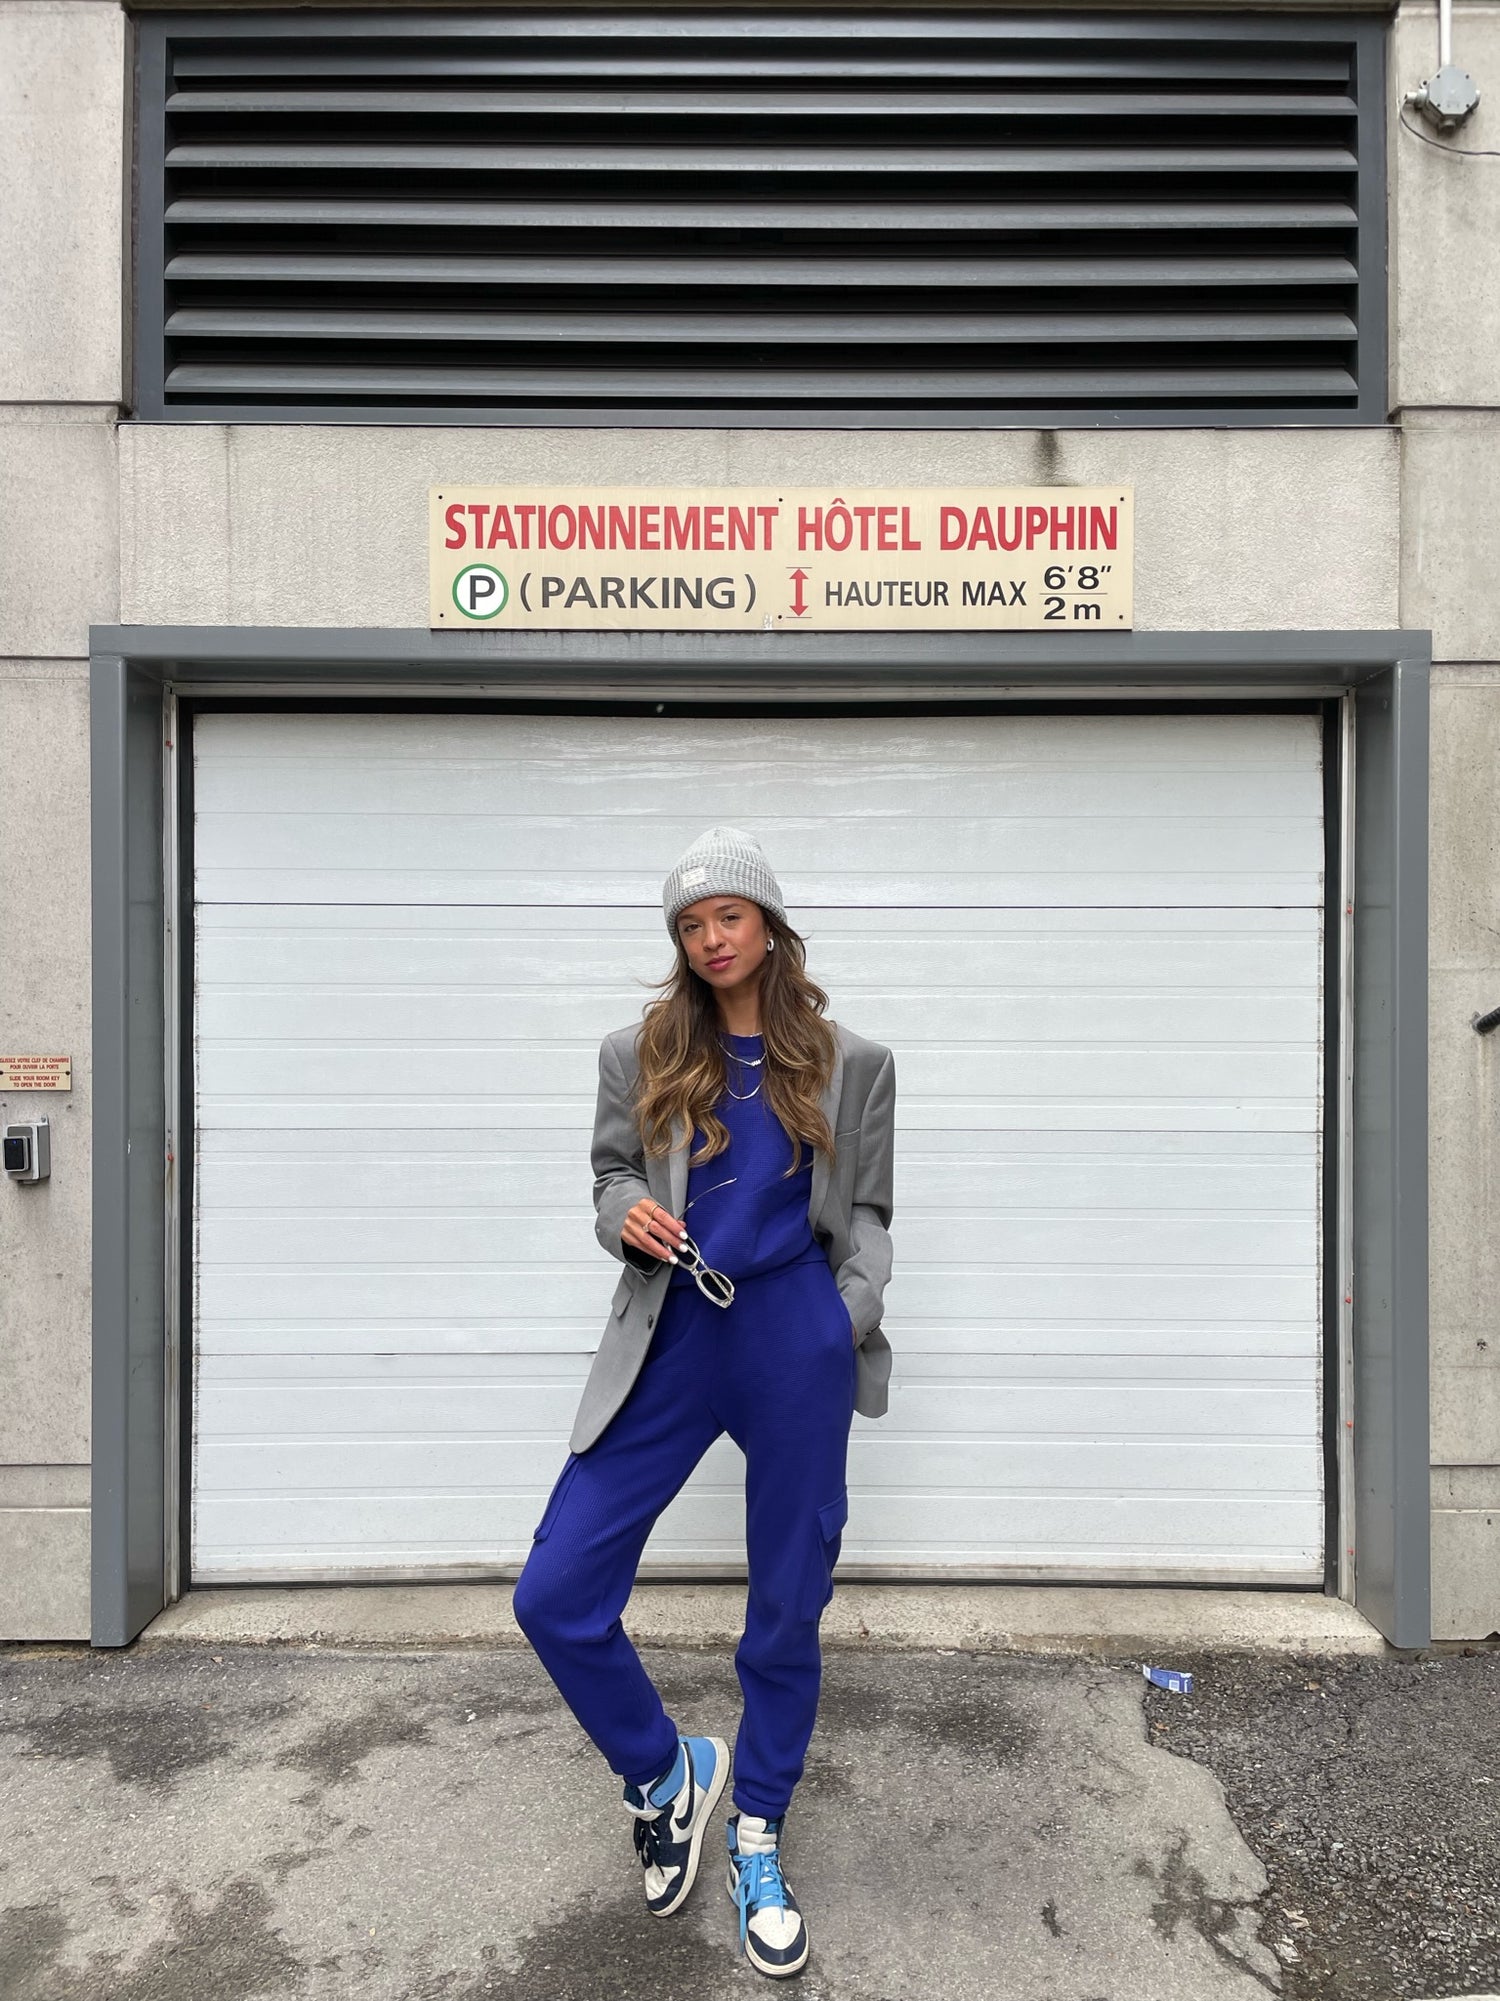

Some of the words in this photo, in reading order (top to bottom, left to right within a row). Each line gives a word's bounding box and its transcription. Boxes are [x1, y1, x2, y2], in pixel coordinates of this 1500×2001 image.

[444, 503, 779, 551] STATIONNEMENT
[797, 497, 922, 552] HÔTEL
[940, 505, 1118, 552] DAUPHIN
[469, 574, 496, 610] P
[825, 581, 949, 607] HAUTEUR
[962, 581, 1028, 607] MAX
